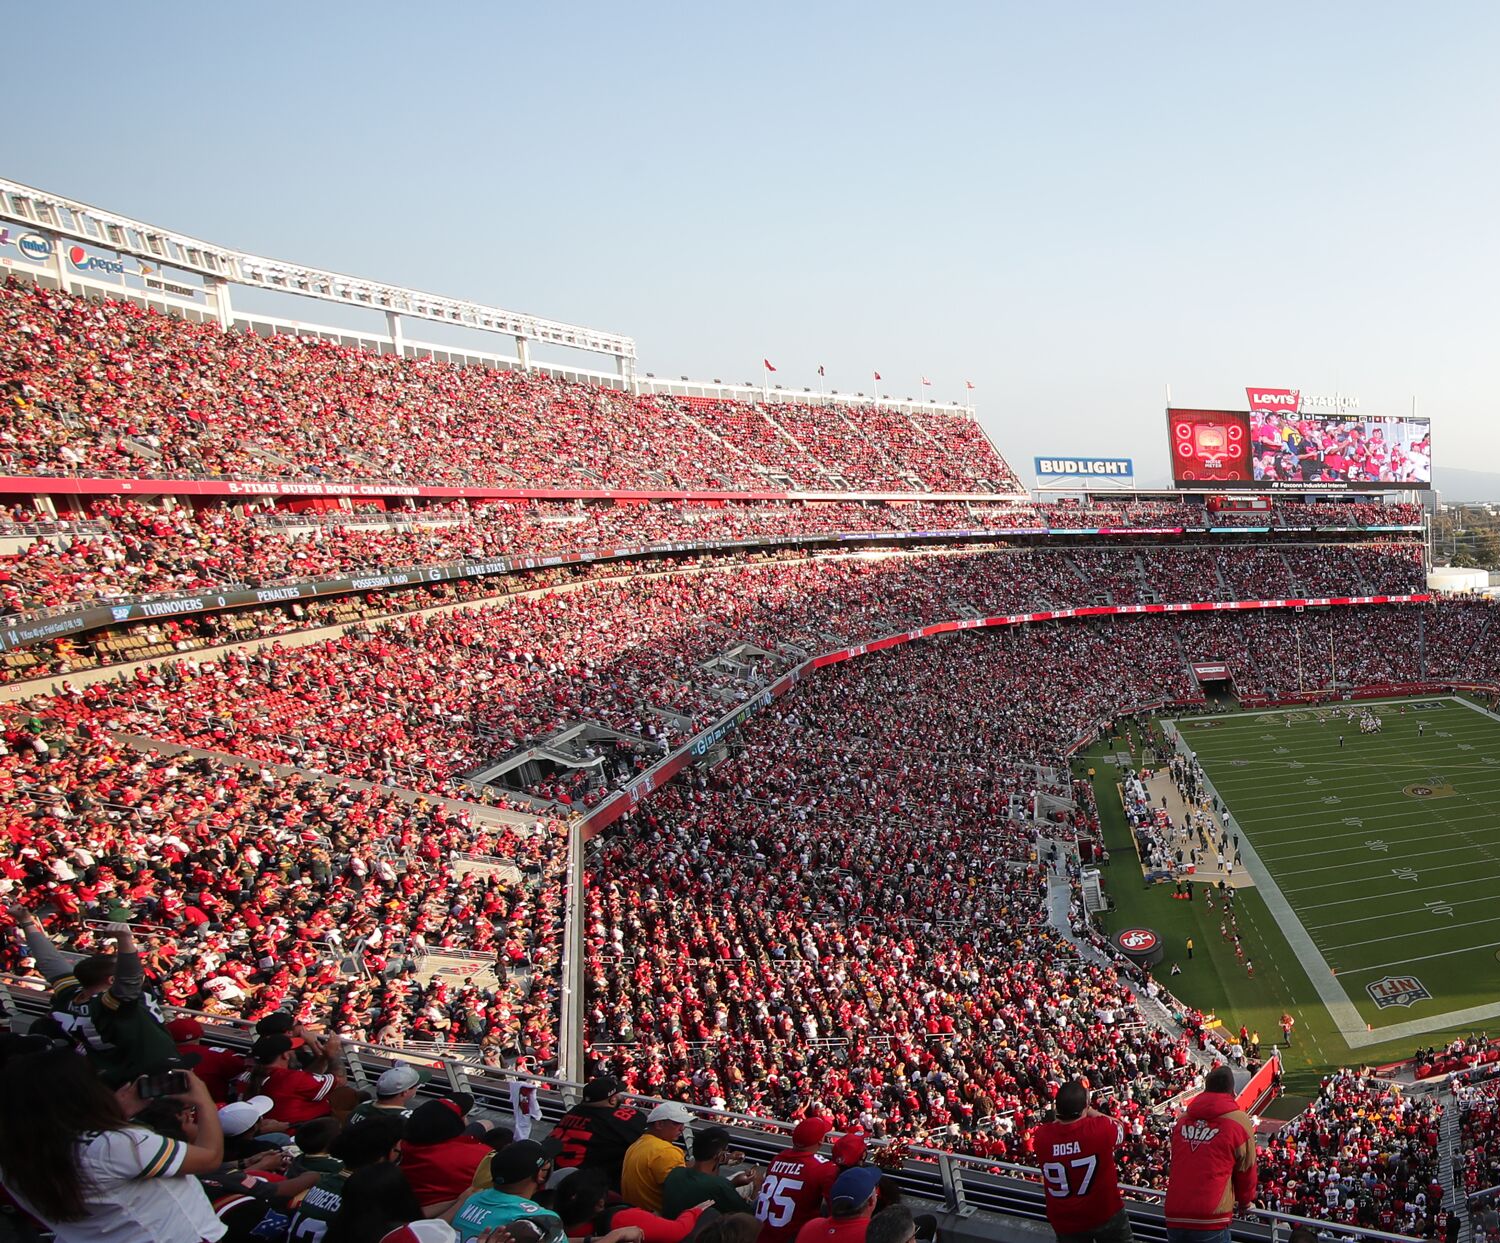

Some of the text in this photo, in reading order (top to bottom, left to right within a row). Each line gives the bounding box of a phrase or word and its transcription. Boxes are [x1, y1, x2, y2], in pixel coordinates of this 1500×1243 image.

[22, 239, 47, 254] intel
[89, 256, 124, 274] pepsi
[1302, 395, 1360, 408] STADIUM
[228, 483, 420, 496] 5-TIME SUPER BOWL CHAMPIONS
[429, 568, 441, 581] G
[466, 562, 506, 576] GAME STATS
[351, 577, 390, 590] POSSESSION
[256, 587, 300, 601] PENALTIES
[113, 608, 129, 619] SAP
[140, 596, 225, 617] TURNOVERS 0
[8, 627, 20, 645] 14
[1391, 867, 1418, 882] 20
[1424, 899, 1454, 917] 10
[1373, 979, 1418, 998] NFL
[1181, 1124, 1219, 1141] 49ERS
[1053, 1140, 1081, 1157] BOSA
[770, 1160, 805, 1175] KITTLE
[1042, 1154, 1097, 1198] 97
[304, 1184, 344, 1214] RODGERS
[755, 1174, 805, 1228] 85
[461, 1203, 492, 1226] WAKE
